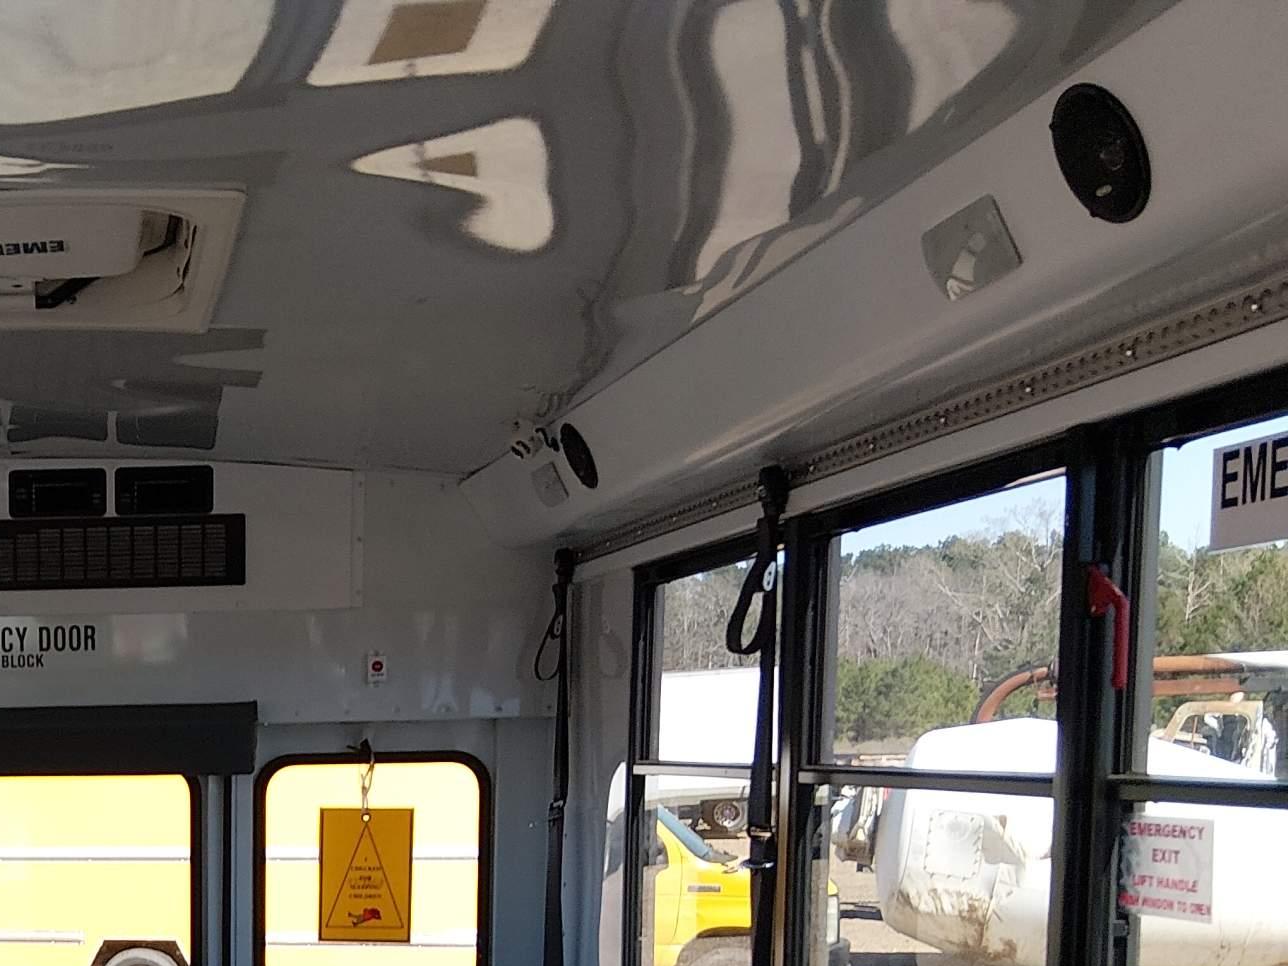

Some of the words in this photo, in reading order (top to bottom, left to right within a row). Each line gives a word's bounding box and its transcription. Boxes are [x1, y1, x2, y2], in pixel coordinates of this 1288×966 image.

[38, 625, 97, 652] DOOR
[1, 654, 44, 669] BLOCK
[1128, 821, 1206, 840] EMERGENCY
[1151, 847, 1180, 865] EXIT
[1156, 876, 1199, 893] HANDLE
